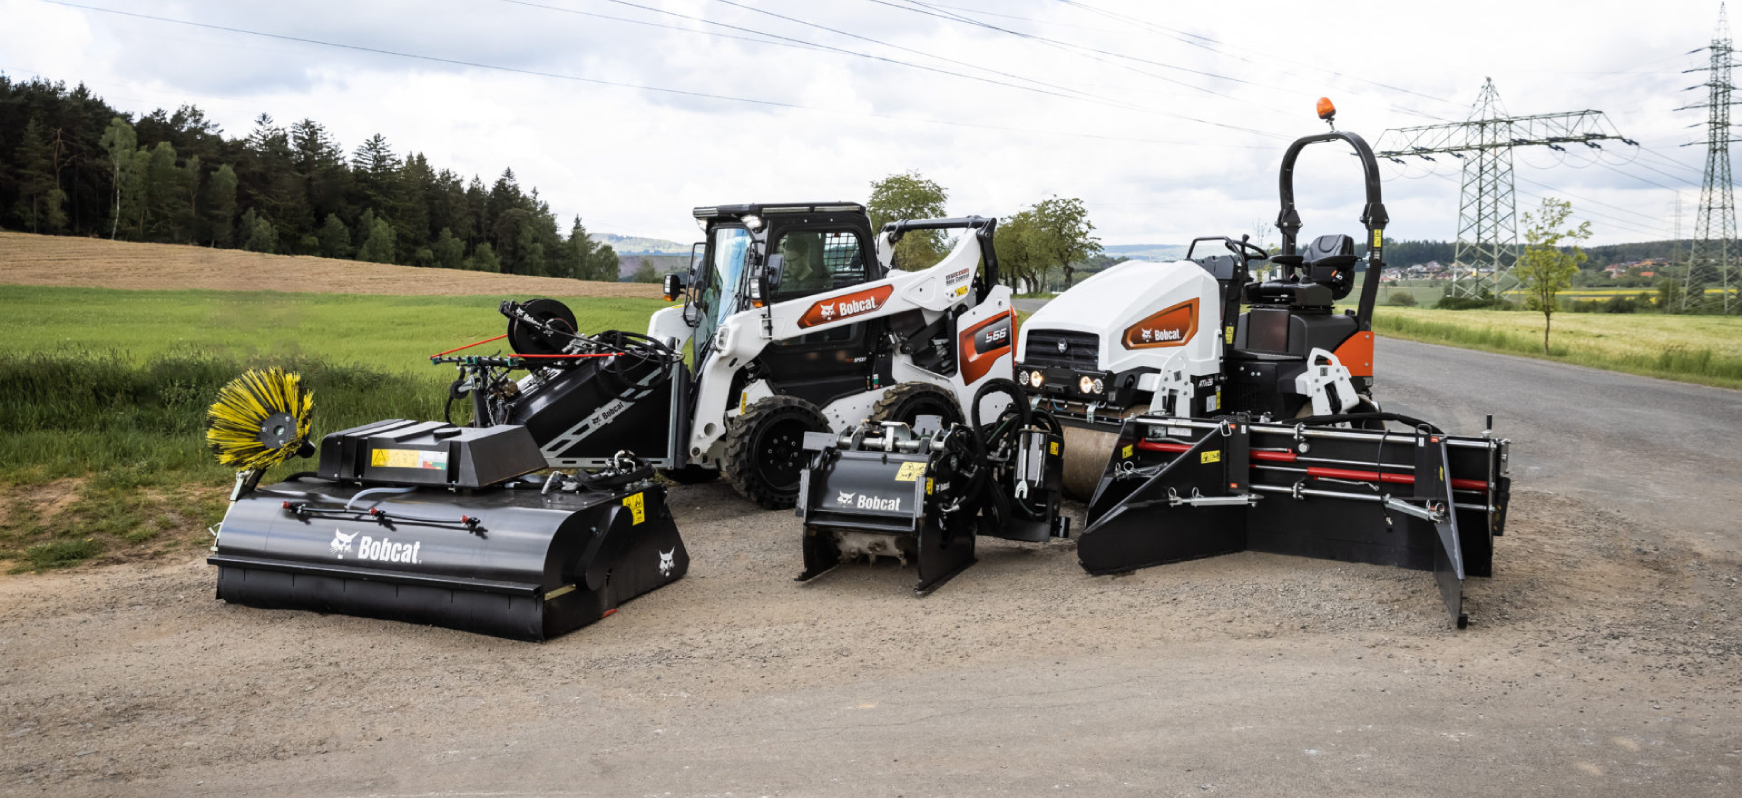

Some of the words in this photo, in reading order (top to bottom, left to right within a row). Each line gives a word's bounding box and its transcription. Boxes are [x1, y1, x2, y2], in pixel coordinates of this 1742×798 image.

[839, 296, 876, 316] Bobcat
[985, 328, 1007, 343] S66
[1154, 328, 1180, 341] Bobcat
[602, 402, 624, 420] Bobcat
[857, 495, 901, 511] Bobcat
[358, 536, 421, 564] Bobcat
